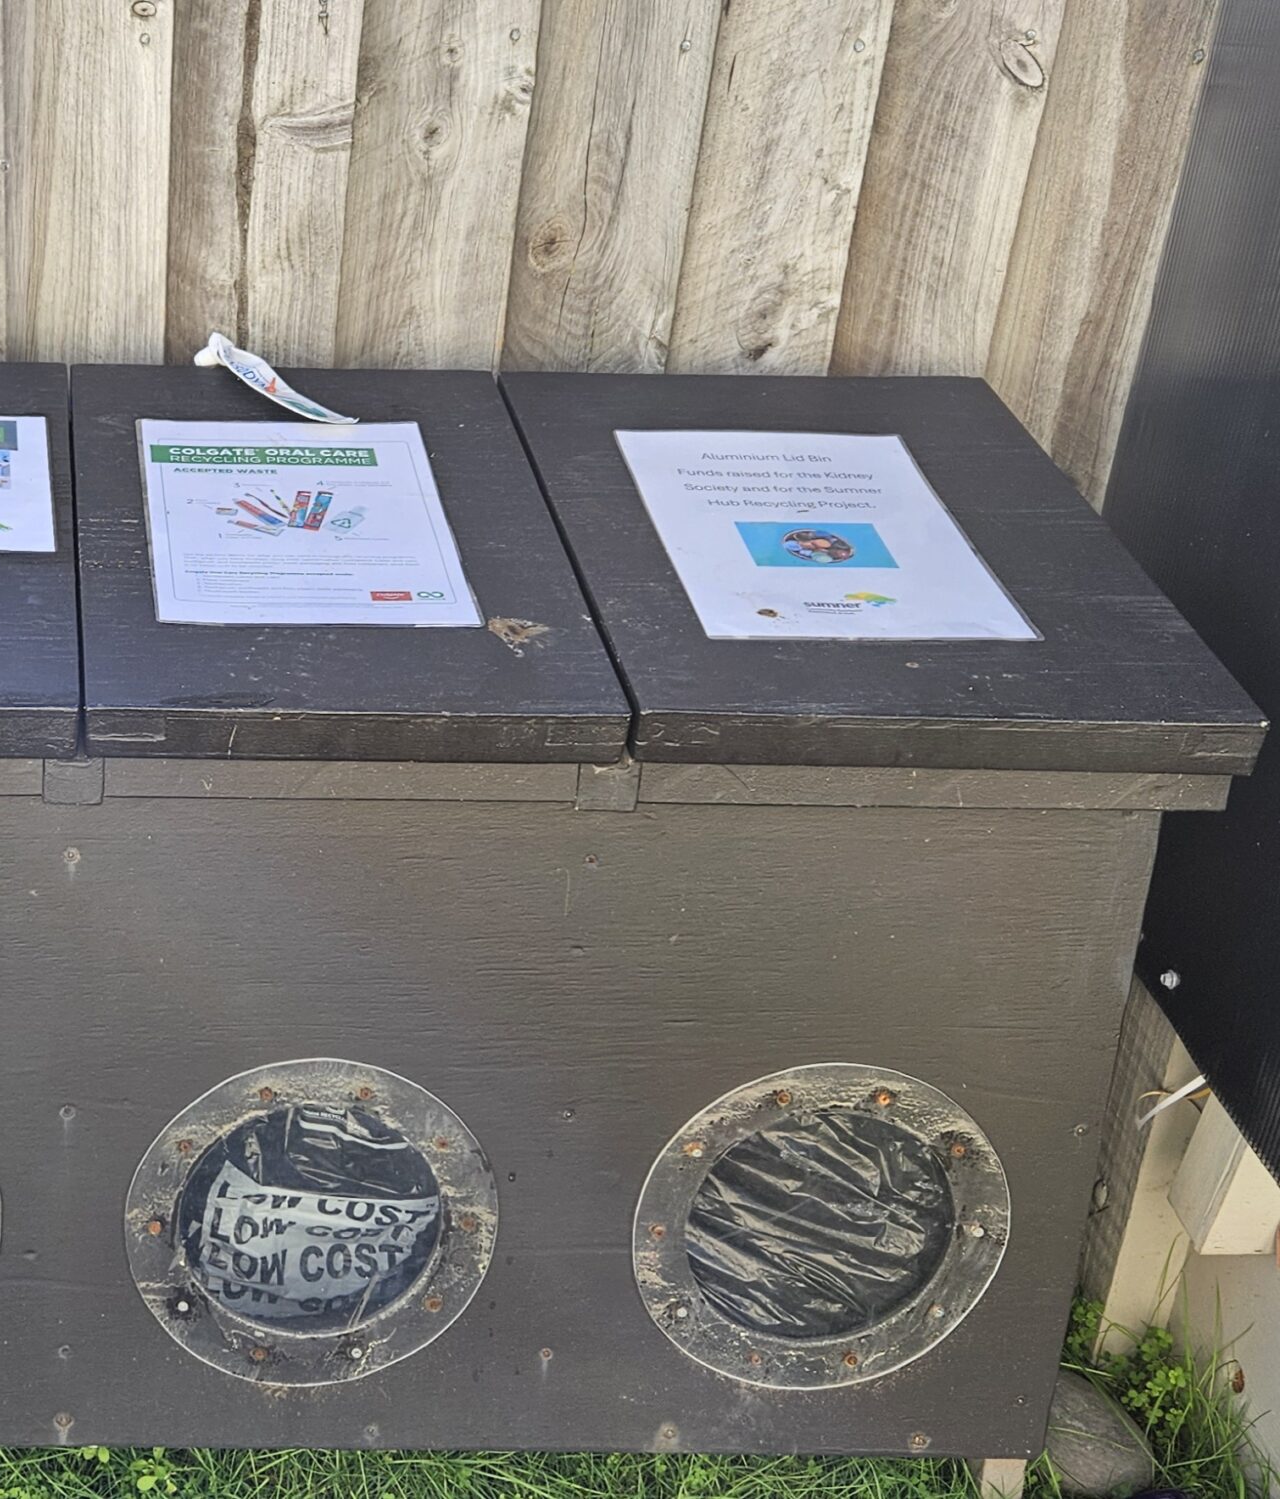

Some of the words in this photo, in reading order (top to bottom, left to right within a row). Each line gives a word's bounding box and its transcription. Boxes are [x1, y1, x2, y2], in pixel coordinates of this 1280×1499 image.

[168, 447, 256, 456] COLGATE
[264, 448, 315, 456] ORAL
[169, 455, 261, 463] RECYCLING
[266, 457, 372, 465] PROGRAMME
[701, 453, 780, 461] Aluminium
[782, 454, 805, 462] Lid
[677, 469, 723, 477] Funds
[823, 472, 873, 480] Kidney
[684, 483, 738, 493] Society
[743, 500, 817, 509] Recycling
[819, 501, 876, 510] Project.
[208, 1241, 288, 1286] LOW
[300, 1243, 404, 1282] COST
